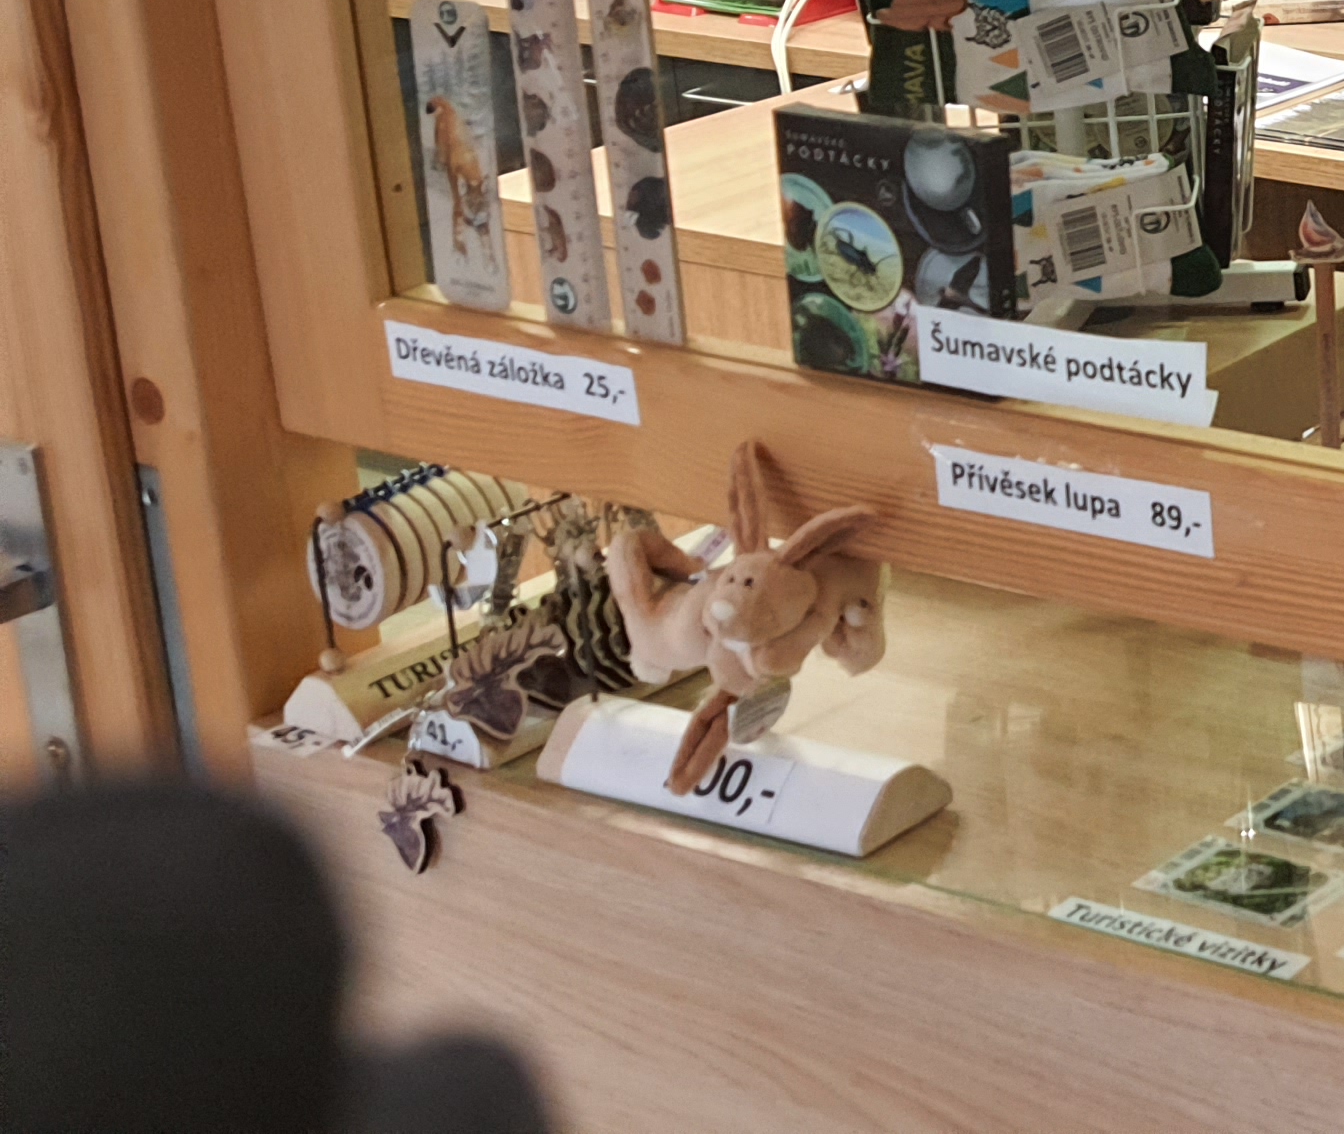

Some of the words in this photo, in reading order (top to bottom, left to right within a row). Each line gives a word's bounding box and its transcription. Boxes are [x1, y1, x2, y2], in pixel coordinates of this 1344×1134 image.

[394, 334, 482, 376] Dřevěná
[486, 354, 566, 392] záložka
[582, 370, 627, 406] 25,-
[930, 320, 1057, 373] Šumavské
[1066, 356, 1193, 398] podtácky
[951, 461, 1059, 507] Přívěsek
[1065, 482, 1122, 520] lupa
[1151, 501, 1203, 537] 89,-
[426, 717, 464, 751] 41,-
[1065, 902, 1195, 949] Turistické
[1198, 939, 1288, 976] vizitky
